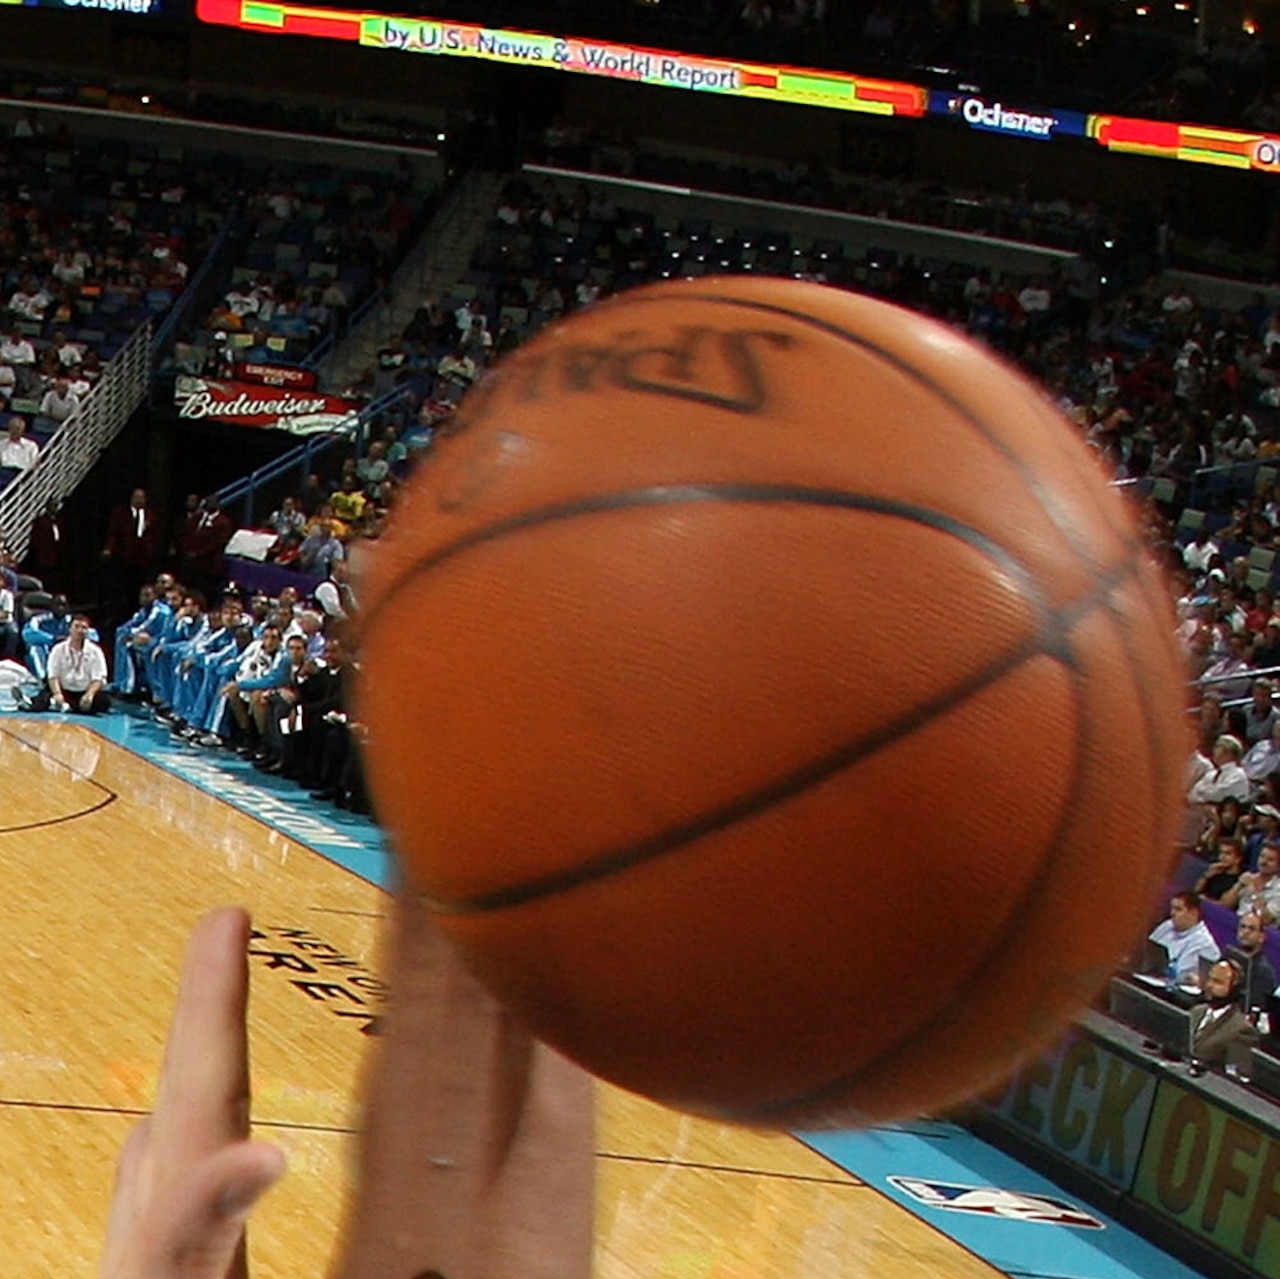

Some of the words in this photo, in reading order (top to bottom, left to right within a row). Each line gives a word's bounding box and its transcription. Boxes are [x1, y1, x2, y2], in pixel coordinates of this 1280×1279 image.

[384, 20, 410, 50] by
[419, 25, 467, 51] U.S.
[477, 31, 543, 61] News
[551, 42, 569, 64] &
[580, 46, 651, 77] World
[660, 58, 736, 90] Report
[963, 98, 1055, 135] Ochsner
[179, 391, 326, 420] Budweiser
